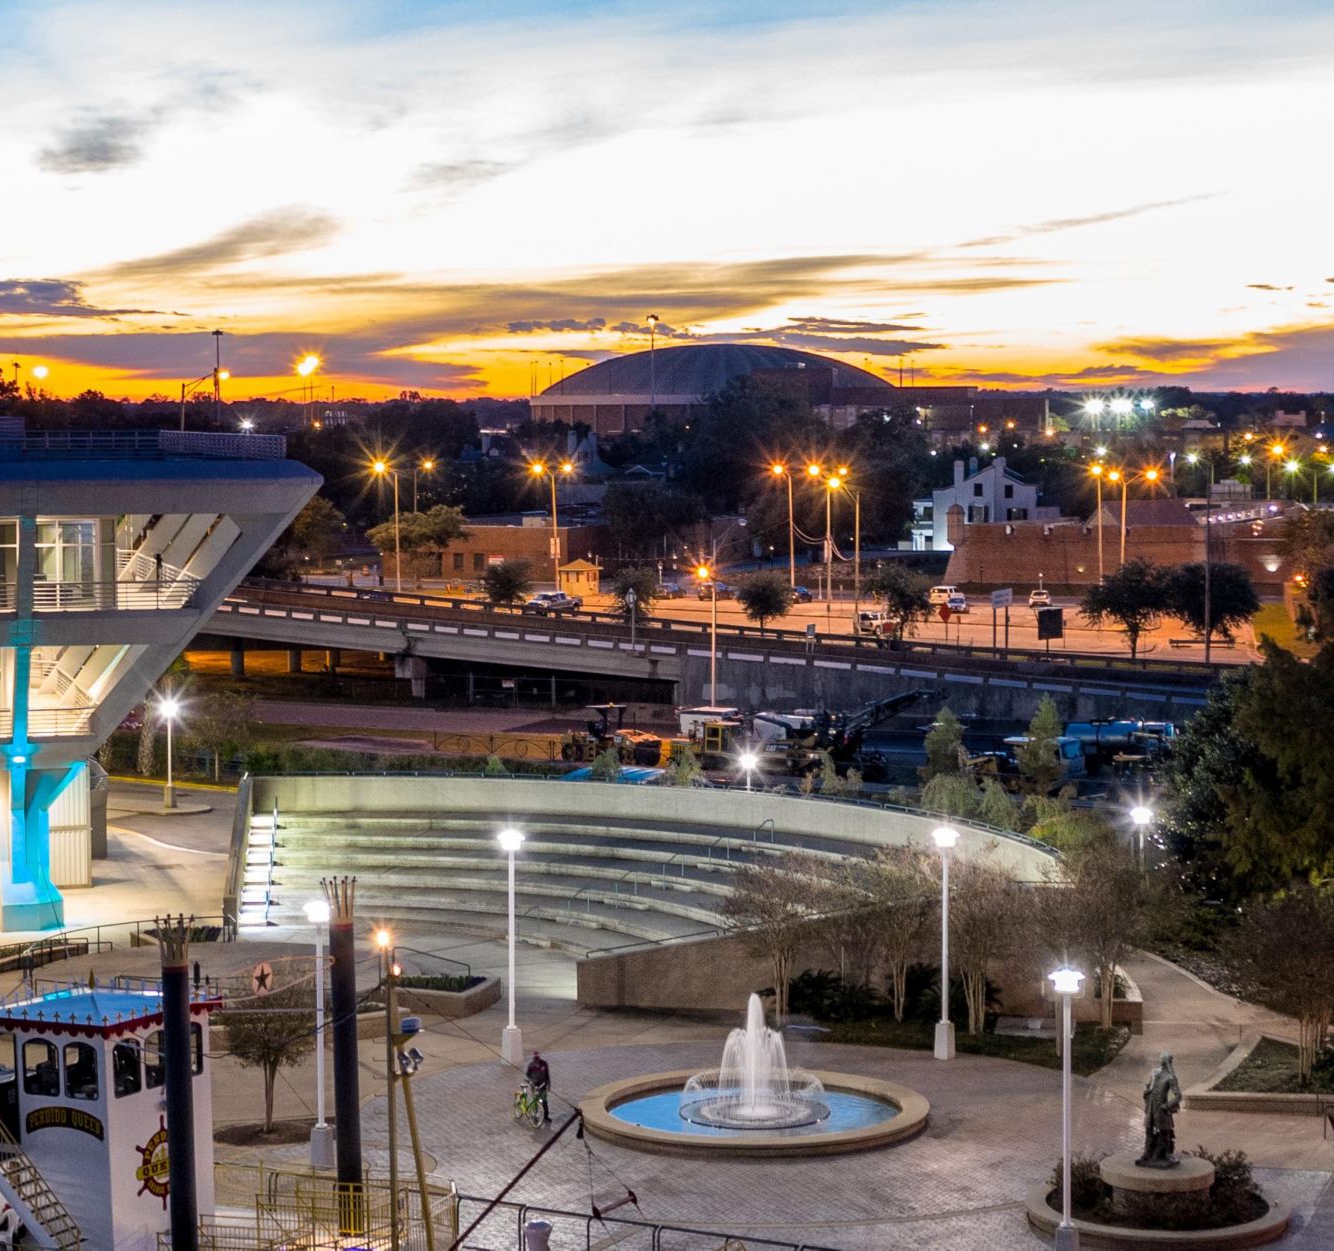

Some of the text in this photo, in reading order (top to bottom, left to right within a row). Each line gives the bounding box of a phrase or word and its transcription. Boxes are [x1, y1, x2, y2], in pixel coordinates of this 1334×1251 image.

[29, 1109, 101, 1134] PERDIDO QUEEN
[144, 1131, 167, 1160] PERD
[142, 1161, 167, 1176] QUE
